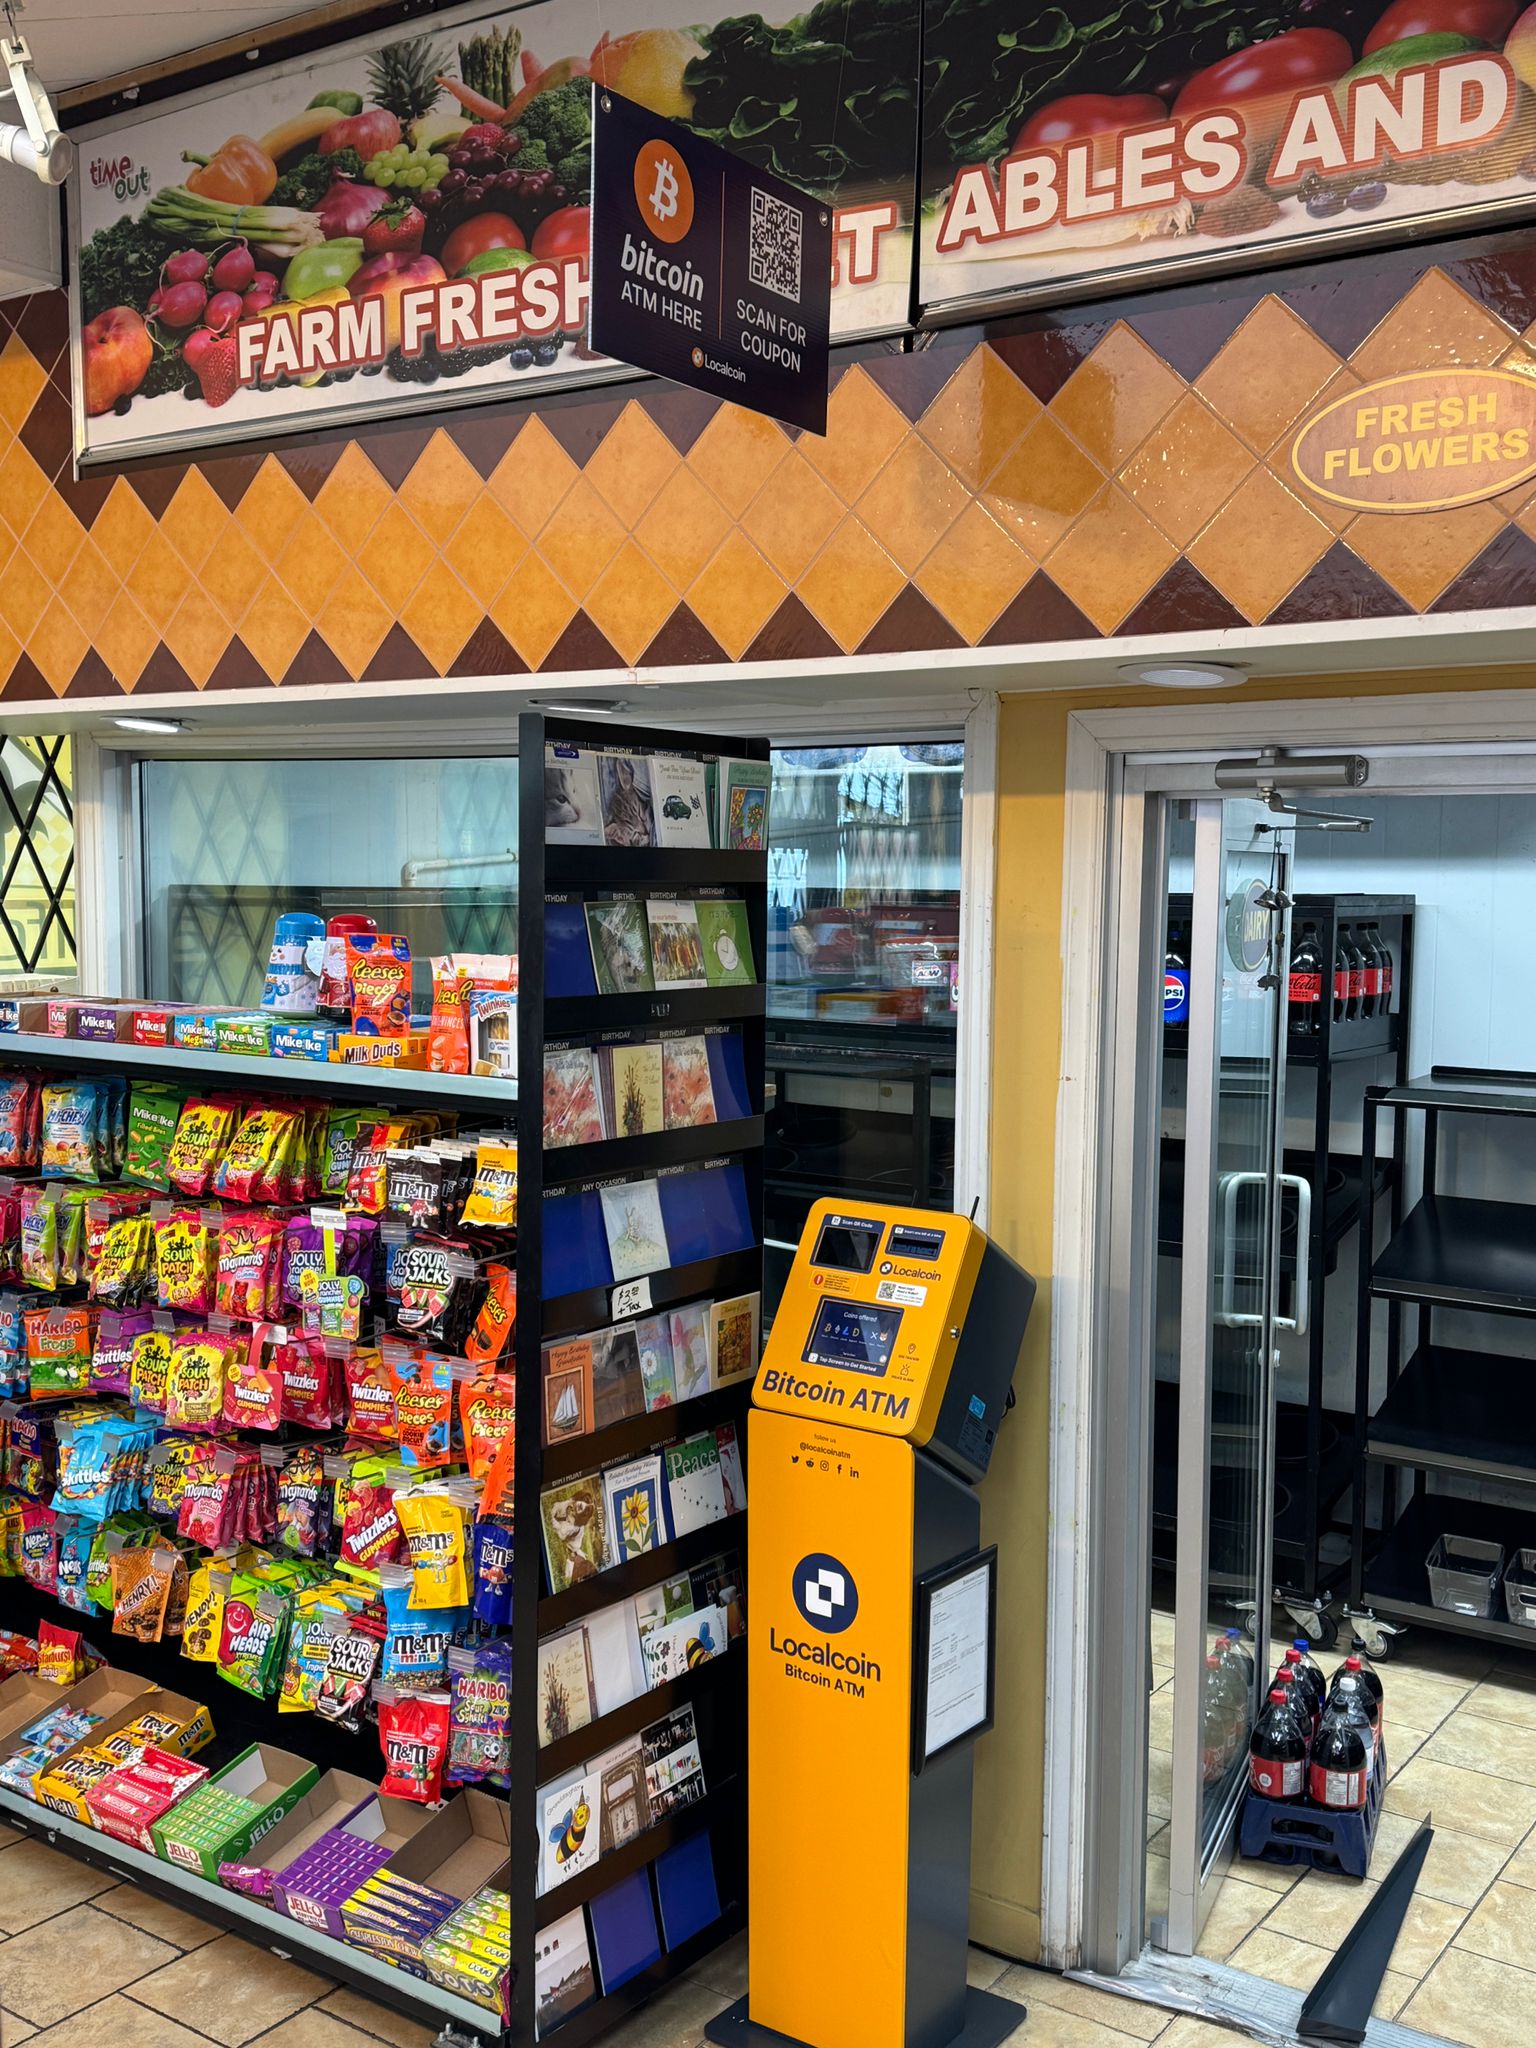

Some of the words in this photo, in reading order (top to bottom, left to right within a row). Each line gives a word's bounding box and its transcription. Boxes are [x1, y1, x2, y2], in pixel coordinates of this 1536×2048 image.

[942, 117, 1240, 247] ABLES
[1274, 59, 1508, 178] AND
[115, 166, 148, 199] out
[620, 234, 704, 301] bitcoin
[238, 299, 382, 379] FARM
[403, 262, 591, 351] FRESH
[831, 207, 891, 282] T
[621, 280, 657, 314] ATM
[662, 298, 702, 331] HERE
[737, 299, 776, 334] SCAN
[779, 320, 806, 347] FOR
[741, 331, 801, 373] COUPON
[704, 356, 746, 382] Localcoin
[1355, 391, 1498, 439] FRESH
[1323, 427, 1529, 480] FLOWERS
[650, 892, 677, 900] BIRTHDAY
[699, 887, 726, 896] BIRTHDAY
[352, 957, 405, 981] Reese's
[1165, 988, 1183, 996] PSI
[476, 997, 511, 1018] Twinkies
[51, 1011, 67, 1022] Mik
[81, 1015, 105, 1028] Mike
[136, 1019, 159, 1032] Mike
[180, 1023, 202, 1034] Mike
[659, 1029, 687, 1039] BIRTHDAY
[704, 1026, 730, 1035] BIRTHDAY
[219, 1029, 245, 1042] Mike
[247, 1034, 263, 1045] Ike
[276, 1034, 302, 1048] Mike
[305, 1040, 321, 1051] Ike
[601, 1031, 631, 1041] BIRTHDAY
[345, 1045, 369, 1063] Milk
[372, 1041, 401, 1061] Duds
[544, 1042, 570, 1051] RTHDAY
[47, 1109, 90, 1125] HI-CHEW
[133, 1107, 157, 1122] Mike
[160, 1116, 174, 1127] Ike
[181, 1130, 210, 1146] SOUR
[238, 1131, 264, 1145] SOUR
[333, 1140, 354, 1153] JOL
[176, 1142, 208, 1158] PATCH
[333, 1151, 352, 1161] ranc
[657, 1165, 685, 1177] BIRTHDAY
[704, 1158, 730, 1169] BIRTHDAY
[542, 1187, 566, 1198] RTHDAY
[581, 1182, 594, 1193] ANY
[595, 1177, 626, 1190] OCCASION
[163, 1249, 192, 1262] SOUR
[219, 1251, 264, 1273] Maynards
[290, 1253, 324, 1266] JOLLY
[410, 1251, 446, 1269] SOUR
[161, 1262, 193, 1275] PATCH
[408, 1267, 452, 1284] JACKS
[893, 1265, 942, 1281] Localcoin
[319, 1281, 340, 1291] JOLLY
[843, 1311, 858, 1320] Coins
[858, 1312, 877, 1323] offered
[40, 1337, 76, 1351] Frogs
[92, 1349, 133, 1367] Skittles
[140, 1356, 169, 1373] SOUR
[828, 1357, 844, 1366] Screen
[136, 1369, 166, 1387] PATCH
[181, 1367, 208, 1379] SOUR
[282, 1371, 319, 1391] Twizzlers
[178, 1378, 209, 1391] PATCH
[351, 1383, 394, 1402] Twizzler
[234, 1384, 271, 1403] Twizzlers
[285, 1388, 315, 1399] GUMMIES
[396, 1386, 443, 1409] Reese's
[762, 1369, 845, 1406] Bitcoin
[849, 1388, 910, 1419] ATM
[237, 1400, 266, 1412] GUMMIES
[354, 1401, 392, 1412] GUMMIES
[467, 1399, 515, 1422] Reese
[800, 1442, 851, 1459] @localcoinatm
[668, 1449, 716, 1479] Peace
[62, 1469, 109, 1487] Skittles
[154, 1474, 180, 1488] PATCH
[346, 1509, 398, 1554] Twizzlers
[359, 1528, 400, 1562] GUMMIES
[248, 1620, 271, 1640] AIR
[230, 1636, 267, 1656] HEADS
[334, 1638, 369, 1660] SOUR
[770, 1627, 881, 1682] Localcoin
[330, 1655, 371, 1676] JACKS
[400, 1654, 439, 1663] minis
[305, 1661, 326, 1674] Tropic
[785, 1663, 831, 1688] Bitcoin
[834, 1678, 865, 1698] ATM
[458, 1679, 507, 1701] HARIBO
[429, 1968, 496, 1999] DOTS
